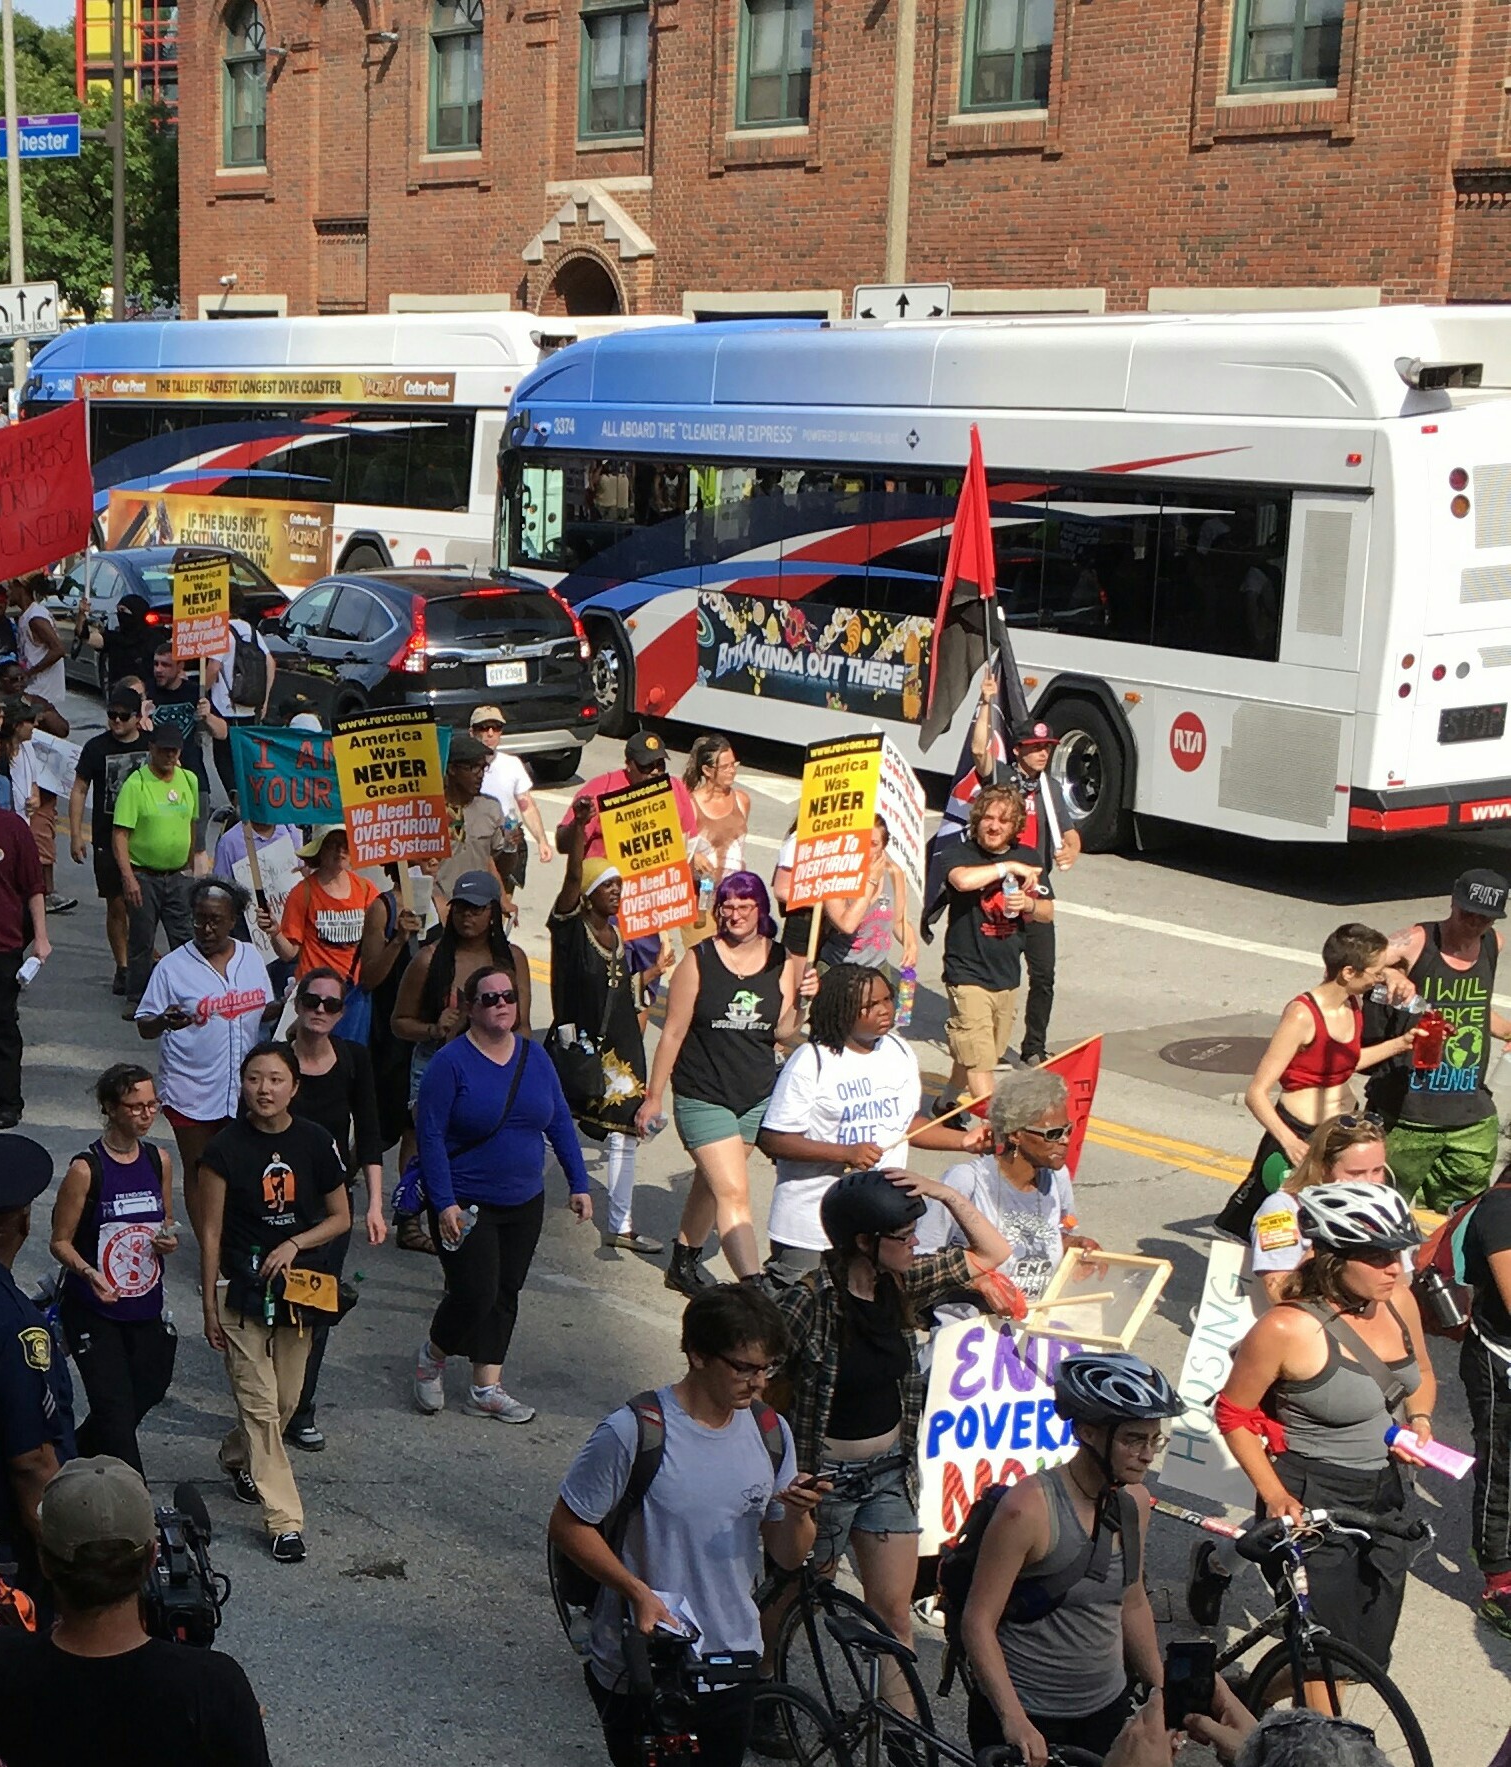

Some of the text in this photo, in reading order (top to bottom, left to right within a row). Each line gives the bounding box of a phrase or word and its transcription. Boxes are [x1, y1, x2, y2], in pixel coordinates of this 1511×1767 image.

[18, 130, 69, 152] hester
[13, 323, 33, 333] ONLY
[35, 321, 54, 331] ONLY
[156, 379, 171, 393] THE
[172, 379, 204, 394] TALLEST
[204, 379, 238, 394] FASTEST
[239, 379, 278, 395] LONGEST
[279, 380, 299, 394] DIVE
[301, 380, 342, 395] COASTER
[403, 379, 427, 396] Cedar
[427, 380, 450, 397] Point
[553, 417, 575, 436] 3374
[601, 420, 618, 438] ALL
[619, 421, 656, 439] ABOARD
[658, 422, 676, 440] THE
[727, 424, 745, 443] AIR
[187, 512, 267, 533] IF THE BUS ISN'T
[180, 528, 273, 553] EXCITING ENOUGH,
[182, 588, 222, 606] NEVER
[754, 644, 905, 691] KINDA OUT THERE
[338, 711, 428, 732] www.revcom.us
[349, 728, 422, 750] America
[1174, 728, 1203, 754] RTA
[252, 738, 275, 770] I
[369, 746, 406, 761] Was
[353, 759, 428, 785] NEVER
[812, 757, 869, 779] America
[248, 775, 333, 809] YOUR
[365, 779, 420, 798] Great!
[824, 777, 850, 792] Was
[351, 800, 432, 826] We Need To
[615, 799, 666, 824] America
[808, 790, 865, 819] NEVER
[353, 817, 442, 845] OVERTHROW
[630, 818, 657, 835] Was
[812, 813, 854, 833] Great!
[356, 835, 445, 863] This System!
[619, 827, 674, 859] NEVER
[797, 834, 860, 862] We Need To
[630, 848, 670, 871] Great!
[794, 853, 865, 883] OVERTHROW
[621, 867, 681, 899] We Need To
[792, 872, 864, 902] This System!
[622, 882, 688, 916] OVERTHROW
[624, 901, 693, 933] This System!
[1424, 977, 1487, 1001] I WILL
[1436, 1006, 1486, 1027] AKE
[836, 1077, 872, 1101] OHIO
[839, 1096, 900, 1124] AGAINST
[836, 1124, 878, 1146] HATE
[1017, 1261, 1052, 1277] END
